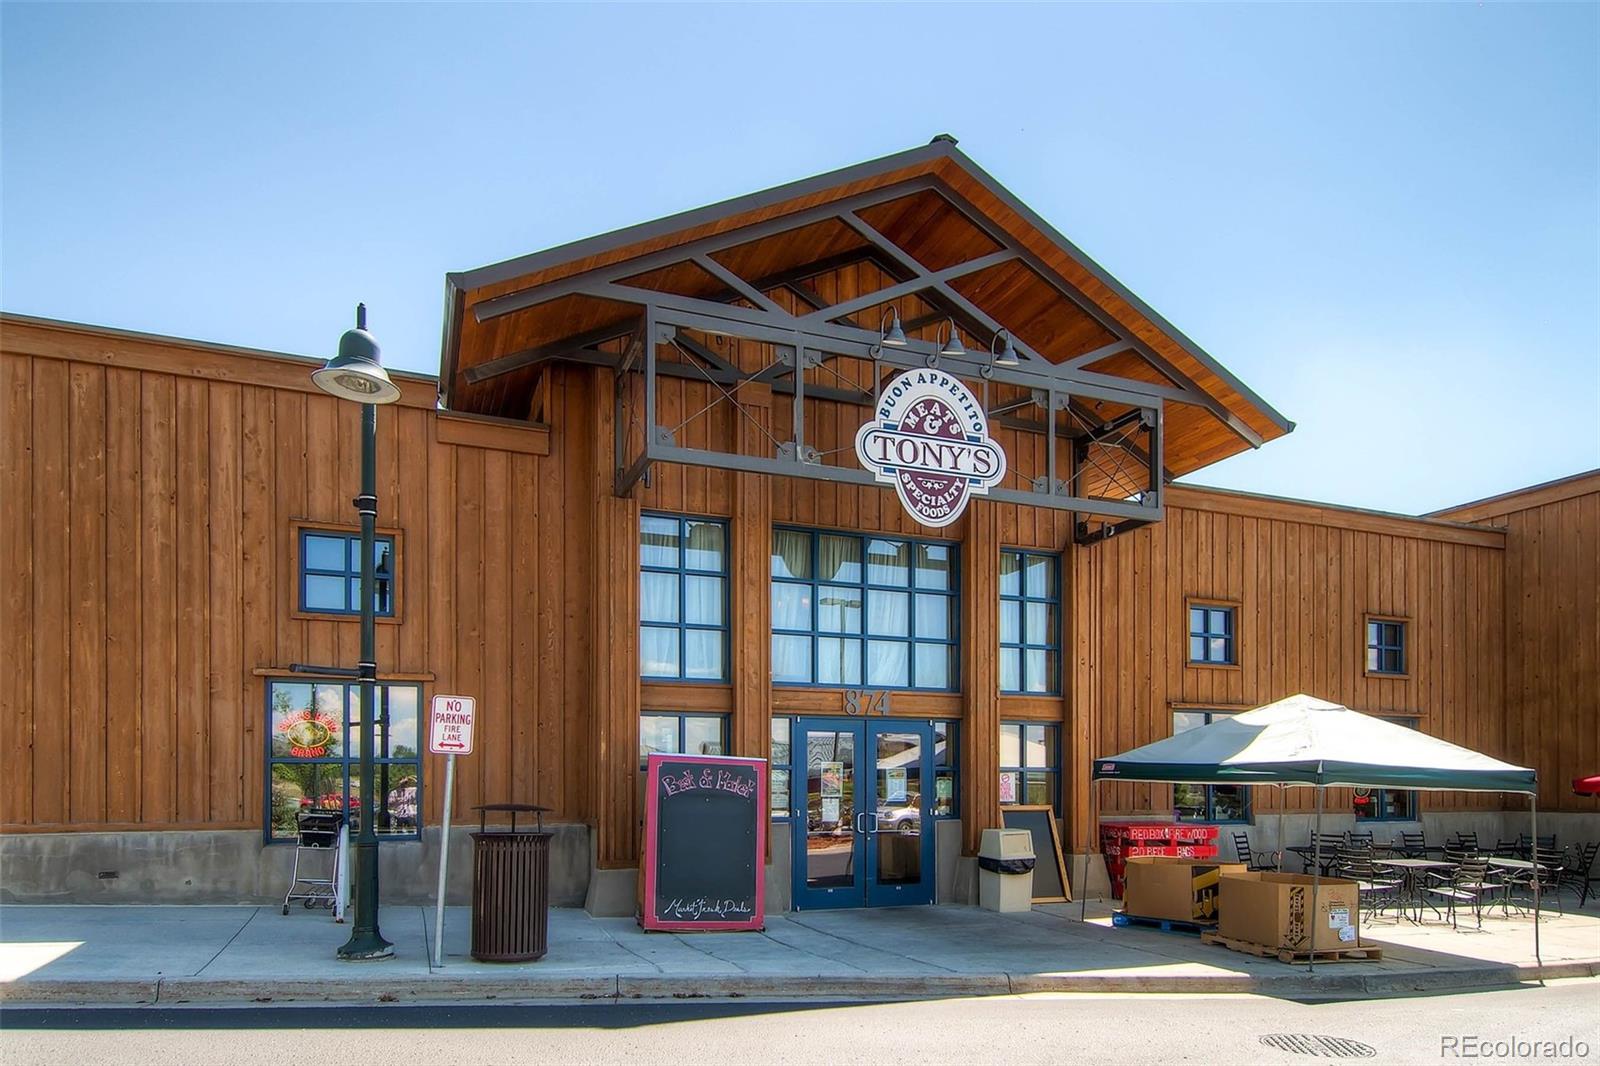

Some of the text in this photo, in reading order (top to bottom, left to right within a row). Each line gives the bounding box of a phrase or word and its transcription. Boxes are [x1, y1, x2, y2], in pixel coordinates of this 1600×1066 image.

[880, 372, 984, 433] BUON APPETITO
[904, 402, 962, 435] MEATS
[923, 415, 943, 435] &
[873, 435, 992, 474] TONY'S
[900, 471, 965, 506] SPECIALTY
[915, 502, 951, 518] FOODS
[446, 701, 462, 712] NO
[844, 688, 890, 716] 874
[435, 713, 471, 725] PARKING
[442, 733, 462, 741] LANE
[444, 725, 462, 733] FIRE
[291, 747, 325, 761] BRAND
[1176, 846, 1195, 857] BAGS
